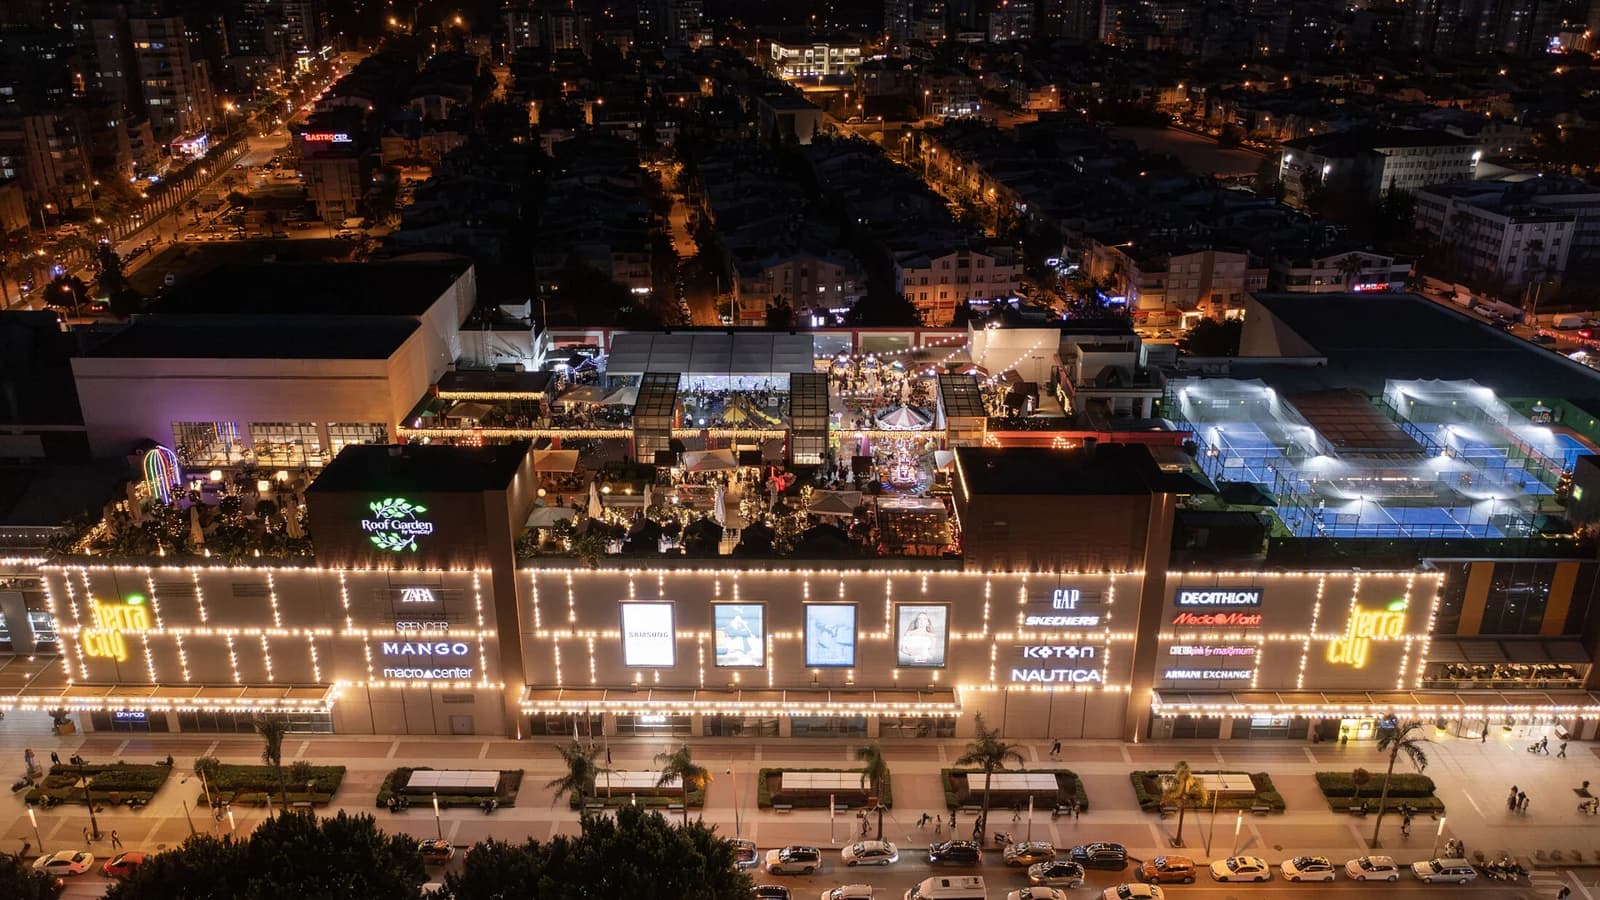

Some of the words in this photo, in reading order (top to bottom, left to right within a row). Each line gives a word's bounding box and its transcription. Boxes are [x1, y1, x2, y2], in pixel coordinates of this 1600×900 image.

[361, 519, 390, 532] Roof
[391, 519, 433, 533] Garden
[400, 587, 435, 602] ZARA
[1052, 589, 1080, 609] GAP
[1180, 591, 1259, 604] DECATHLON
[396, 621, 449, 632] SPENCER
[1025, 616, 1100, 626] SKECHERS
[383, 642, 468, 655] MANGO
[1011, 669, 1101, 682] NAUTICA
[1165, 670, 1201, 679] ARMANI
[1203, 670, 1252, 679] EXCHANGE
